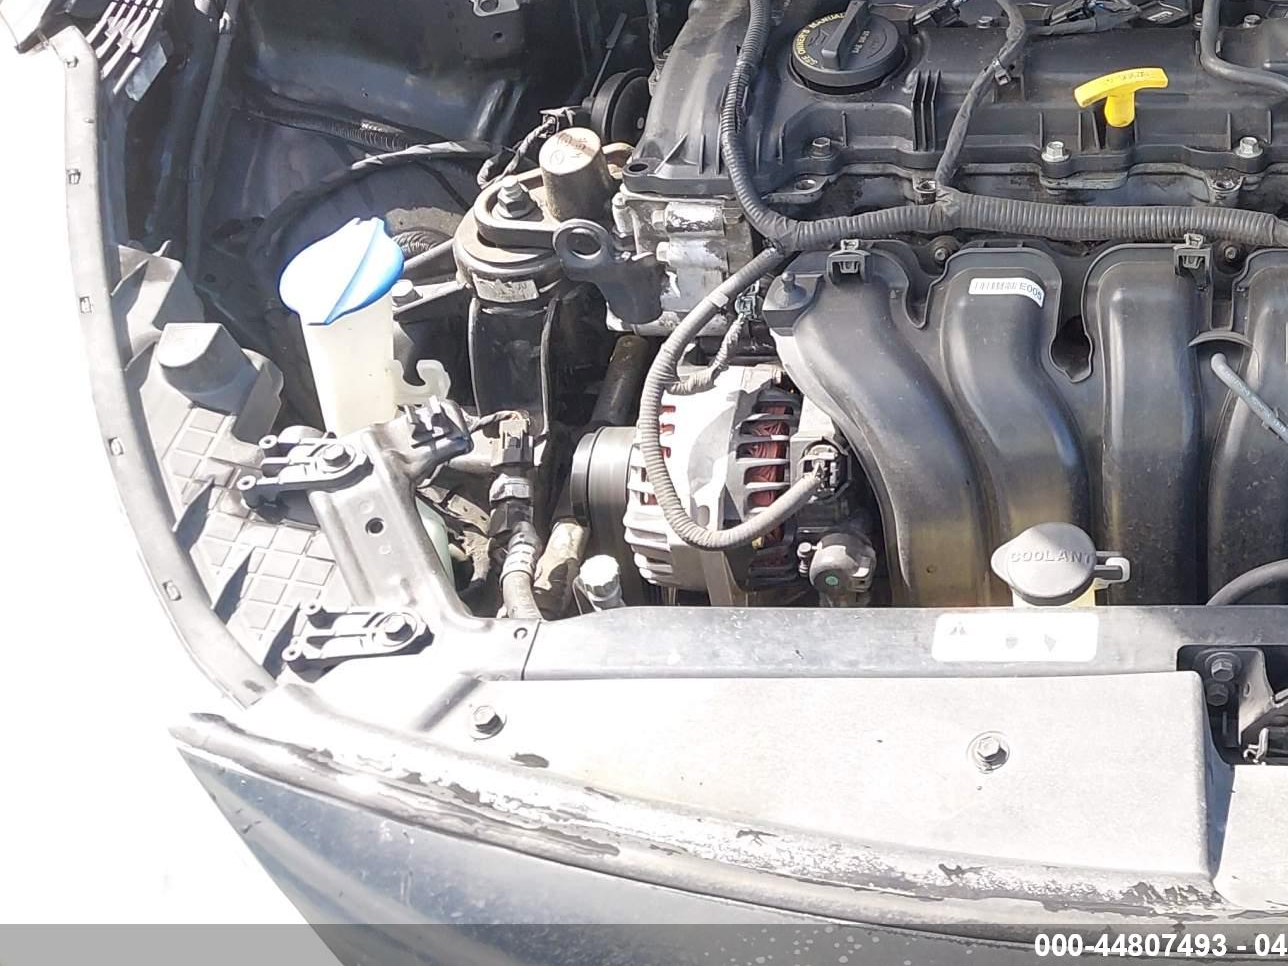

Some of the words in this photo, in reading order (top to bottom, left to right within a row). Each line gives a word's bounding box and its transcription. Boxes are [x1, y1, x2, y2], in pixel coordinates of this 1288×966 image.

[808, 12, 847, 29] MANUAL
[1019, 282, 1042, 300] E005
[1009, 549, 1092, 564] COOLANT
